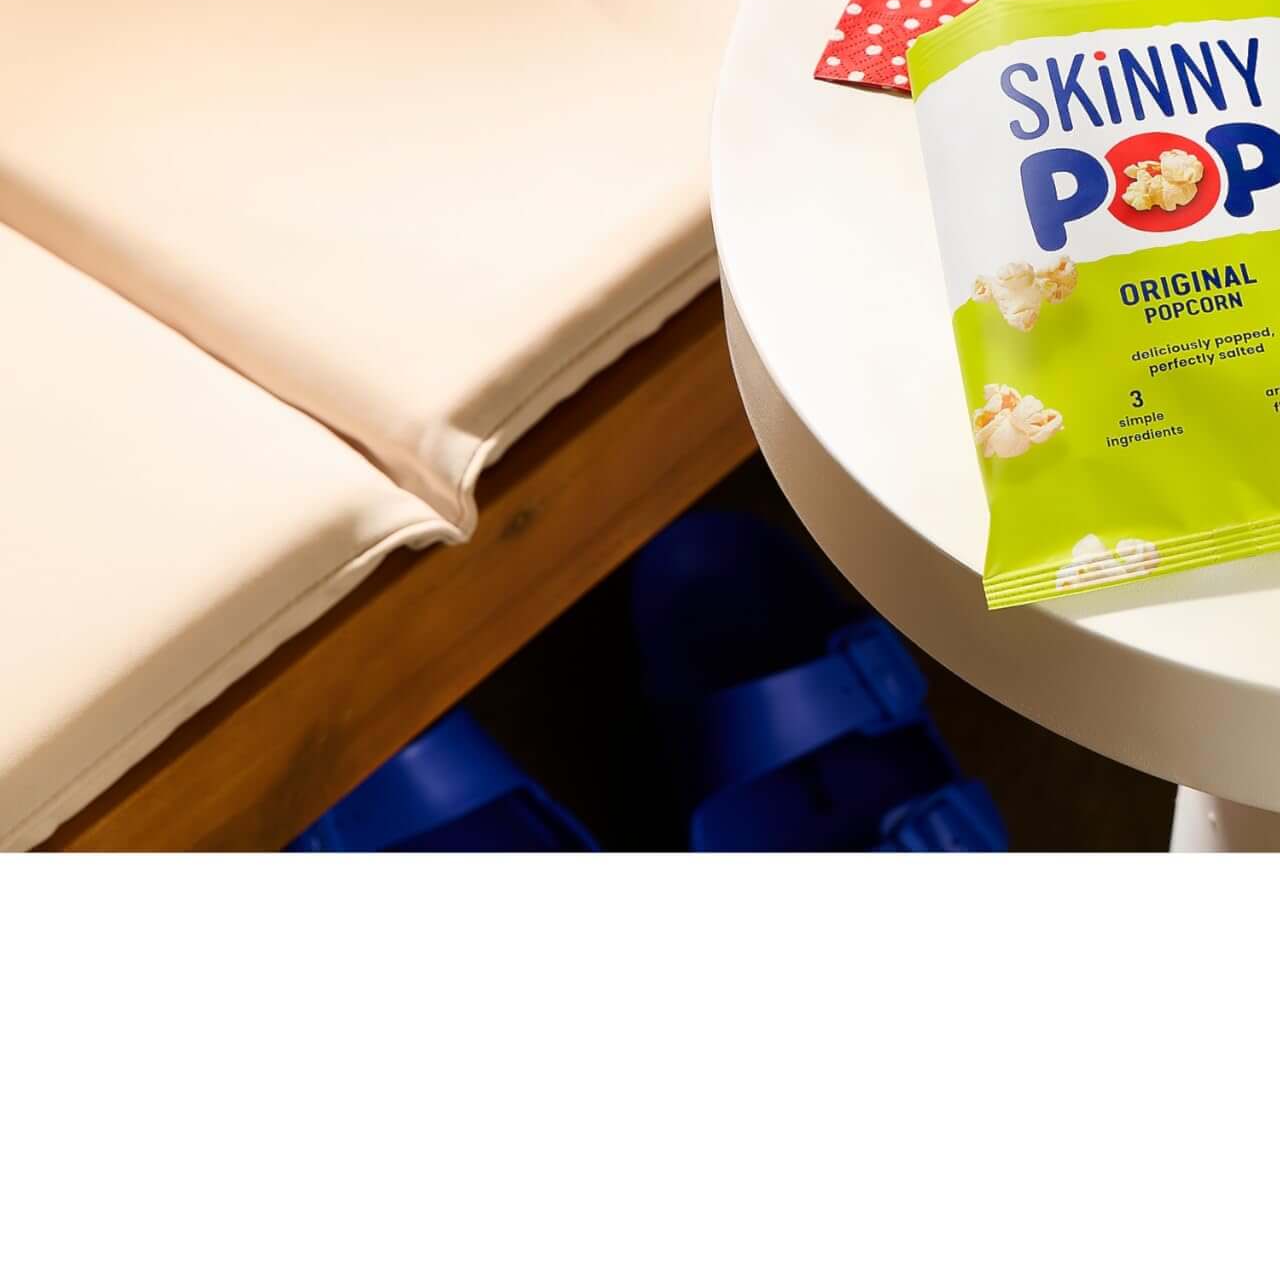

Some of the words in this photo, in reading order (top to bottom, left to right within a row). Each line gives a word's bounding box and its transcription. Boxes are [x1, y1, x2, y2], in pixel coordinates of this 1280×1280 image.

[1119, 263, 1258, 306] ORIGINAL
[1144, 291, 1244, 324] POPCORN
[1131, 338, 1211, 362] deliciously
[1214, 326, 1275, 349] popped,
[1148, 352, 1215, 377] perfectly
[1218, 342, 1265, 360] salted
[1129, 389, 1144, 408] 3
[1106, 425, 1184, 448] ingredients
[1118, 411, 1165, 429] simple
